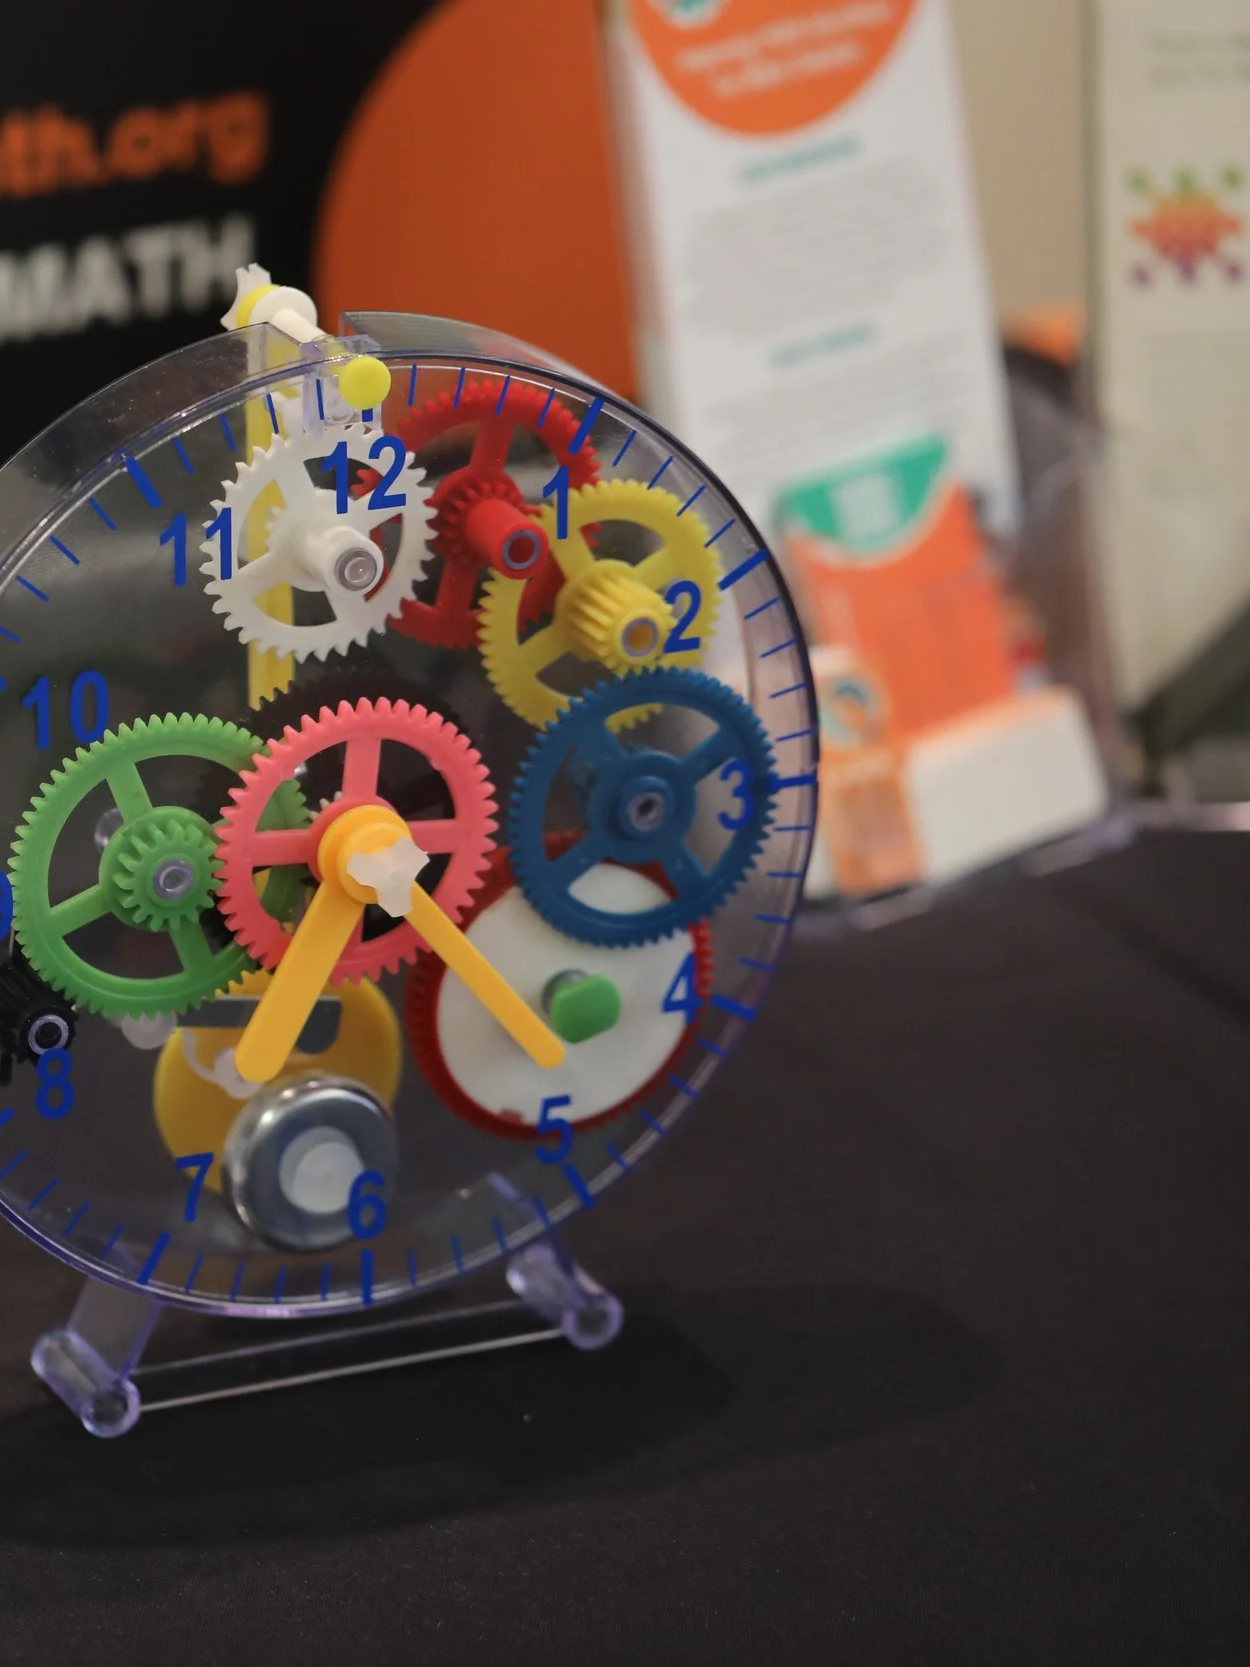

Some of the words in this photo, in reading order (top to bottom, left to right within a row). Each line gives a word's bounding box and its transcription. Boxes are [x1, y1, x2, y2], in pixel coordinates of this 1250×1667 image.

[321, 435, 407, 514] 12
[542, 465, 571, 540] 1
[159, 508, 232, 587] 11
[663, 580, 703, 654] 2
[22, 670, 110, 750] 10
[717, 759, 755, 831] 3
[662, 951, 703, 1024] 4
[35, 1048, 75, 1120] 8
[534, 1095, 572, 1164] 5
[175, 1152, 214, 1223] 7
[347, 1170, 387, 1240] 6
